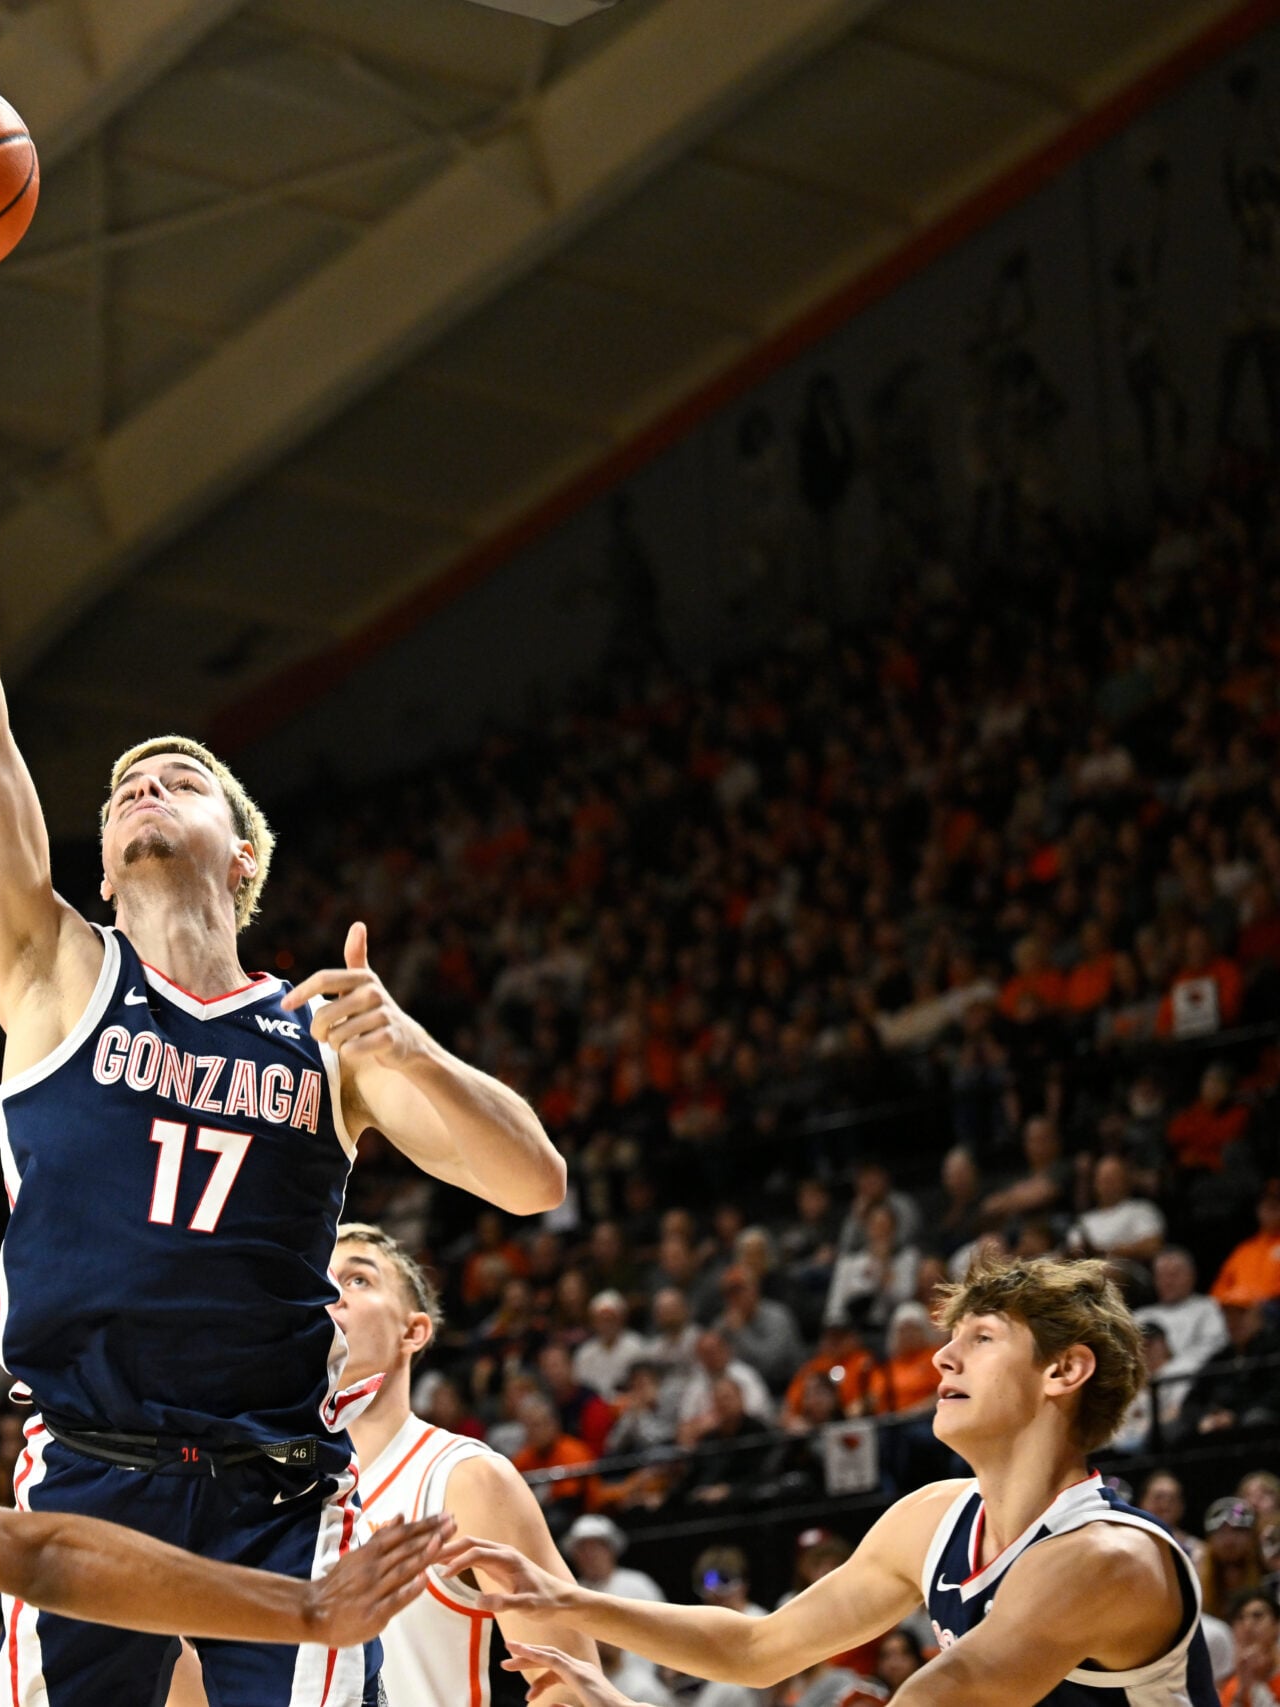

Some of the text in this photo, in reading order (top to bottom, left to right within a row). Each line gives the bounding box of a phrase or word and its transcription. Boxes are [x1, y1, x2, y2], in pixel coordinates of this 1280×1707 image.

[254, 1014, 301, 1040] WCC
[92, 1025, 322, 1134] GONZAGA
[148, 1118, 254, 1233] 17
[292, 1447, 307, 1459] 46
